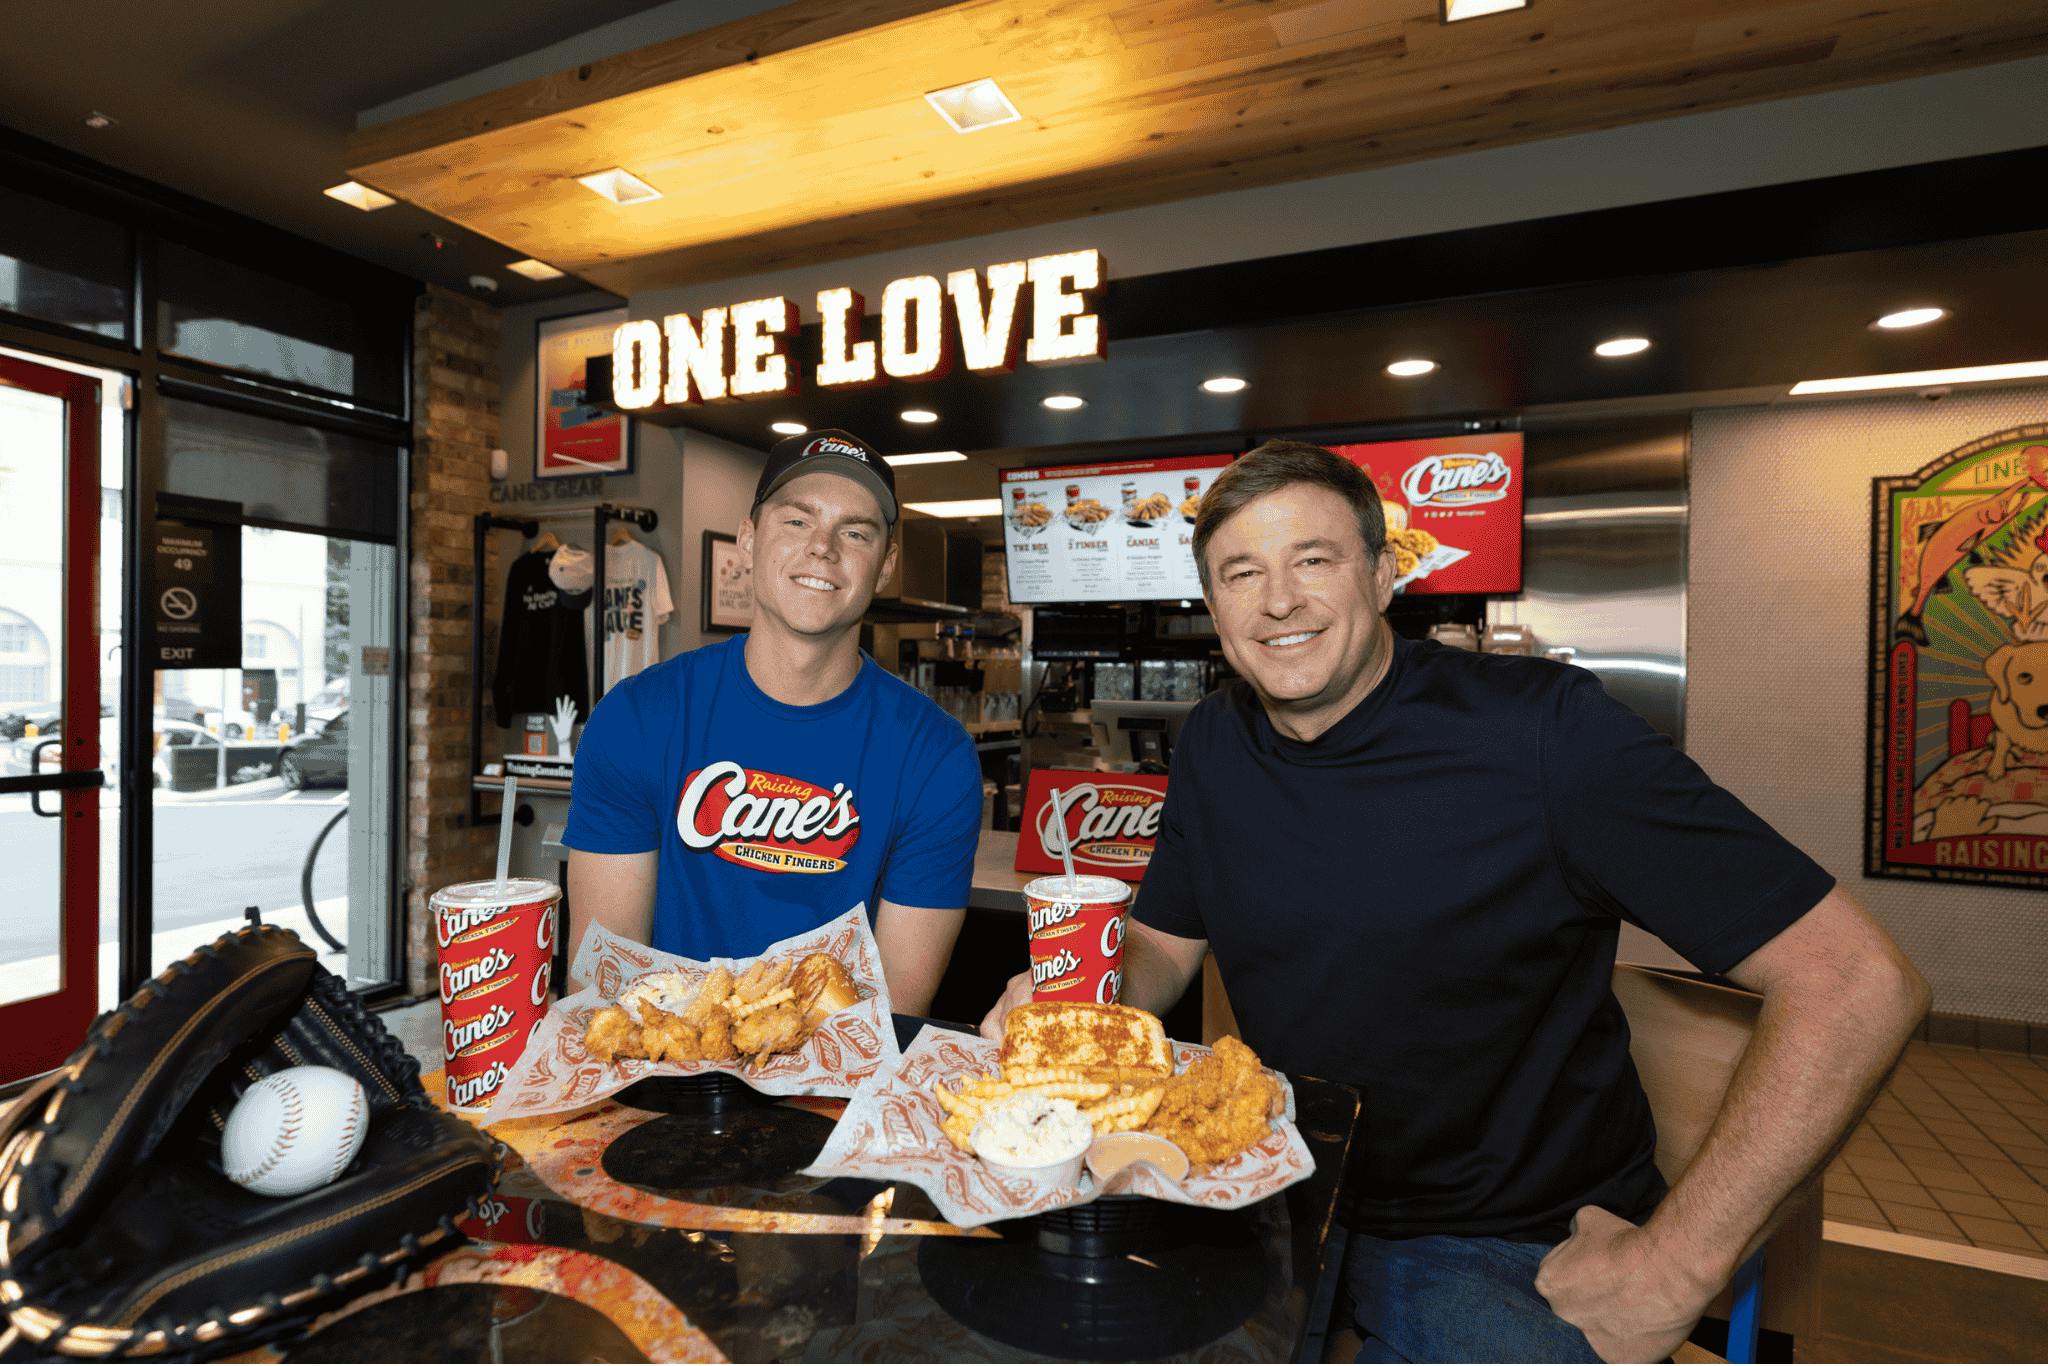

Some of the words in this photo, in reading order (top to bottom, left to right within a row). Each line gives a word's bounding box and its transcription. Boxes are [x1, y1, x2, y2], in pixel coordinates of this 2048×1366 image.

[612, 296, 787, 409] ONE
[816, 249, 1099, 386] LOVE
[802, 438, 870, 462] Cane's
[1408, 452, 1511, 505] Cane's
[173, 558, 193, 571] 49
[160, 647, 194, 660] EXIT
[749, 773, 813, 801] Raising
[1101, 790, 1153, 806] Raising
[677, 761, 860, 850] Cane's
[735, 845, 780, 865] CHICKEN
[783, 854, 836, 871] FINGERS
[1089, 844, 1129, 857] CHICKEN
[1935, 838, 2048, 870] RAISING
[440, 948, 515, 1004] Cane's
[443, 1005, 515, 1061] Cane's
[447, 1061, 512, 1106] Cane's
